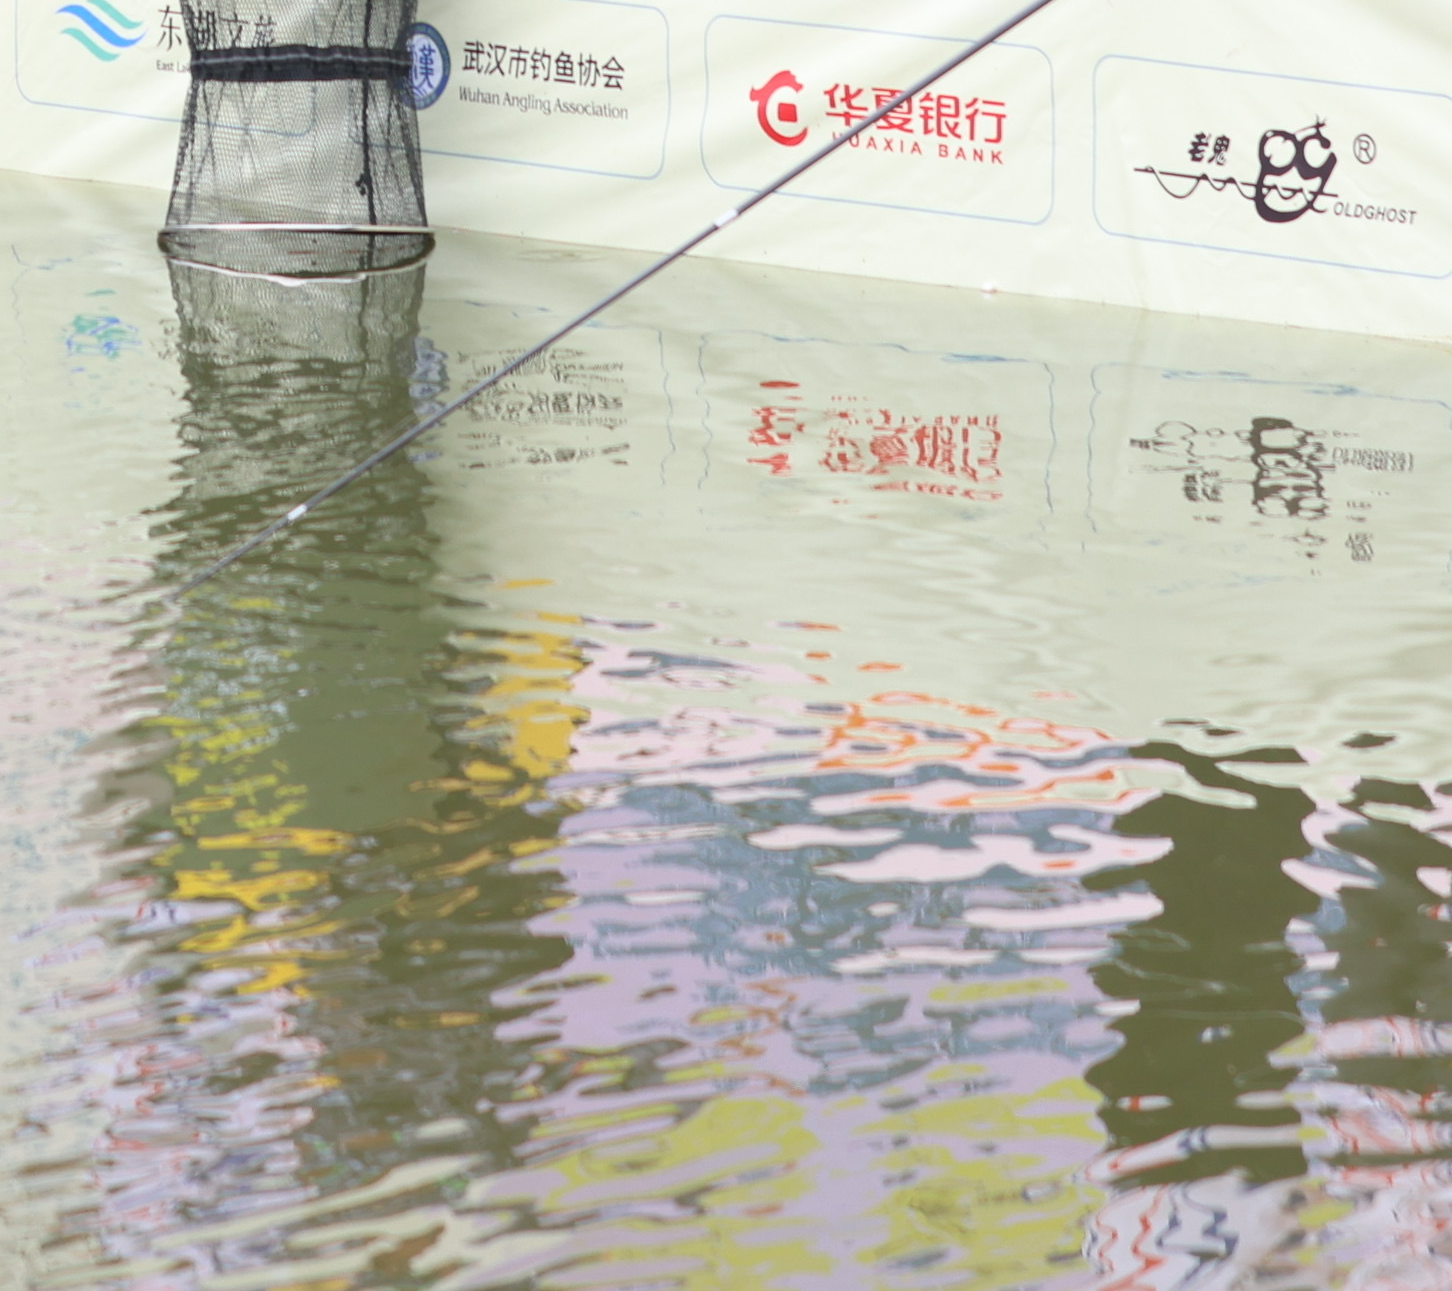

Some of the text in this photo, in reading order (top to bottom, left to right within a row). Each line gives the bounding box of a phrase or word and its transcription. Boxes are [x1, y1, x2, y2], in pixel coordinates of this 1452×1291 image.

[462, 40, 625, 91] 武汉市钓鱼协会
[459, 86, 628, 118] Wuhan Angling Association
[822, 80, 1008, 148] 华夏银行
[939, 143, 1002, 164] BANK
[1334, 202, 1417, 224] OLDGHOST
